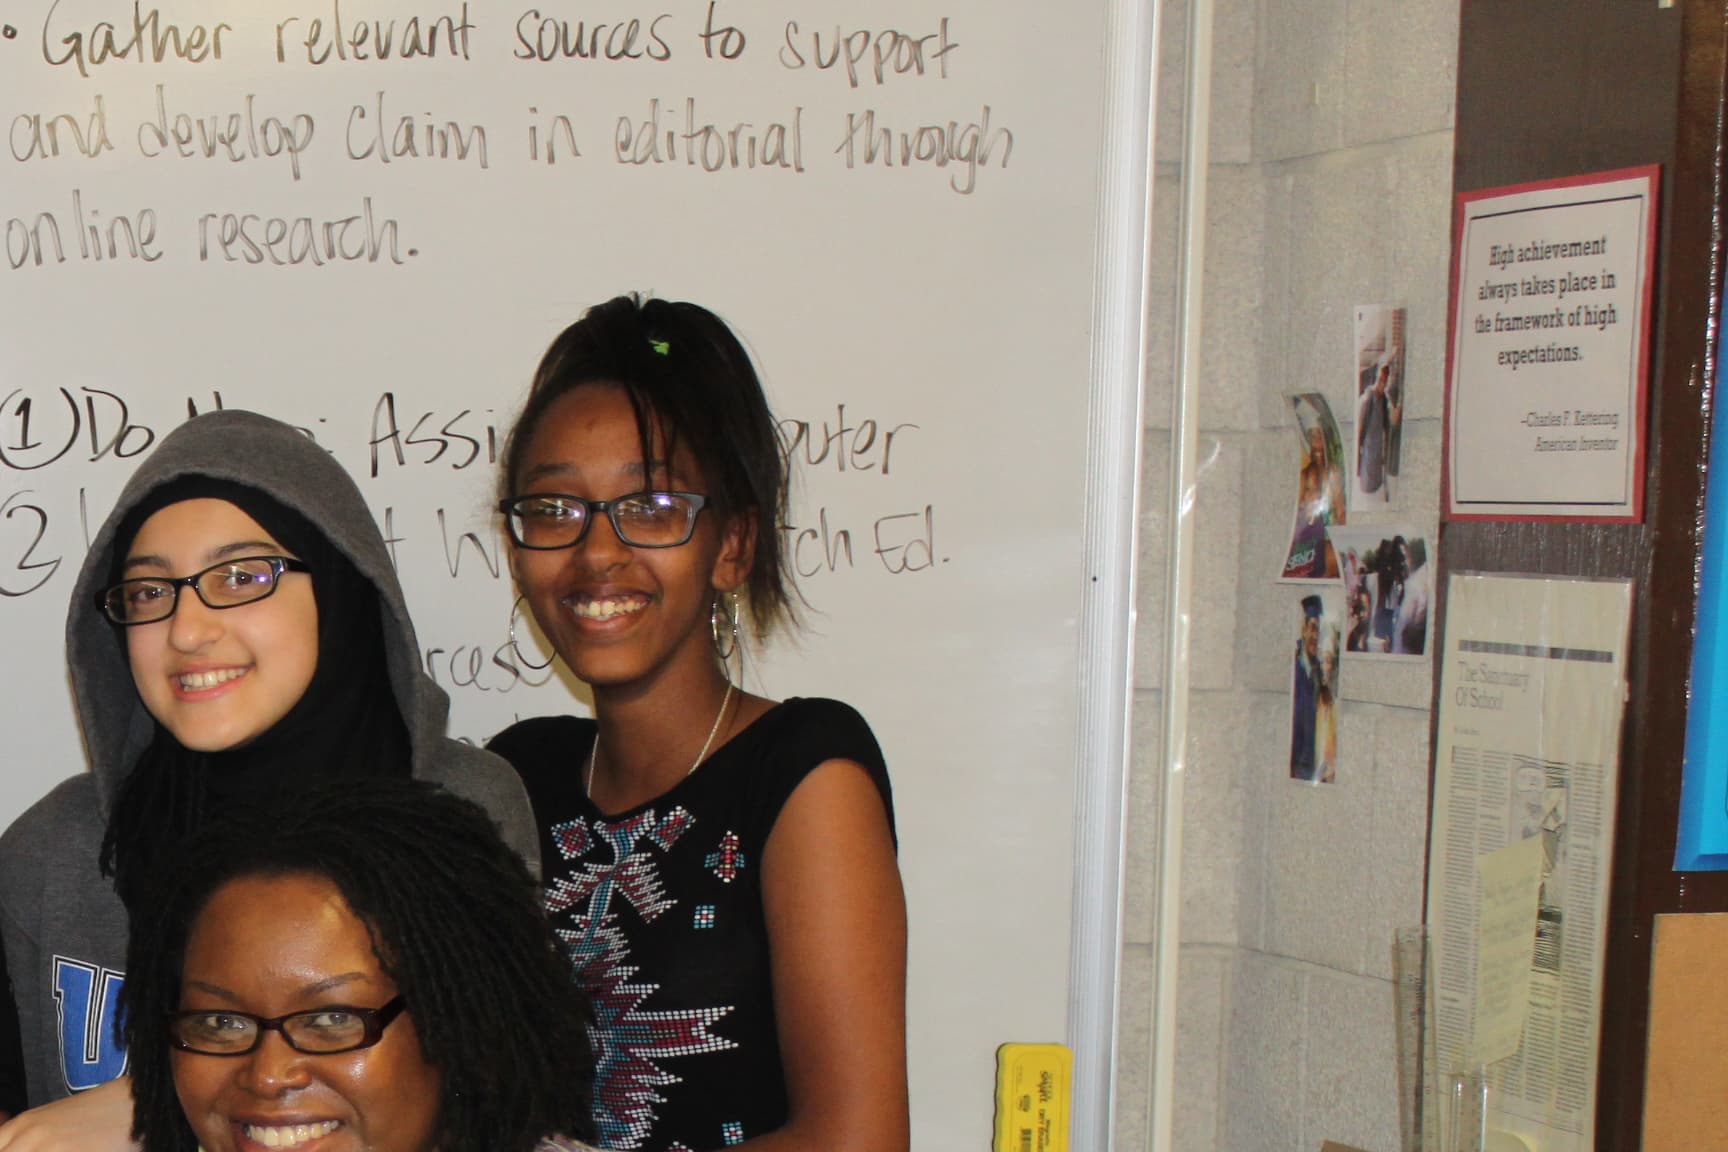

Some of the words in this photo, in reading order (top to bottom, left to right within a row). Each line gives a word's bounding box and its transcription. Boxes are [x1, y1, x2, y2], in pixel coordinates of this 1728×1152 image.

[42, 0, 233, 77] Gather
[275, 0, 476, 65] relevant
[513, 9, 673, 62] sources
[698, 0, 746, 59] to
[778, 16, 960, 88] support
[9, 94, 115, 162] and
[138, 84, 315, 181] develop
[527, 106, 582, 165] in
[615, 97, 806, 173] editorial
[834, 105, 1014, 195] through
[198, 196, 420, 267] research.
[1517, 235, 1607, 263] achievement
[1479, 278, 1518, 304] always
[1521, 271, 1556, 297] takes
[1558, 269, 1597, 299] place
[1601, 268, 1616, 290] in
[1474, 314, 1492, 334] the
[1494, 308, 1565, 333] framework
[1567, 305, 1583, 327] of
[1584, 303, 1617, 332] high
[1497, 341, 1583, 371] expectations.
